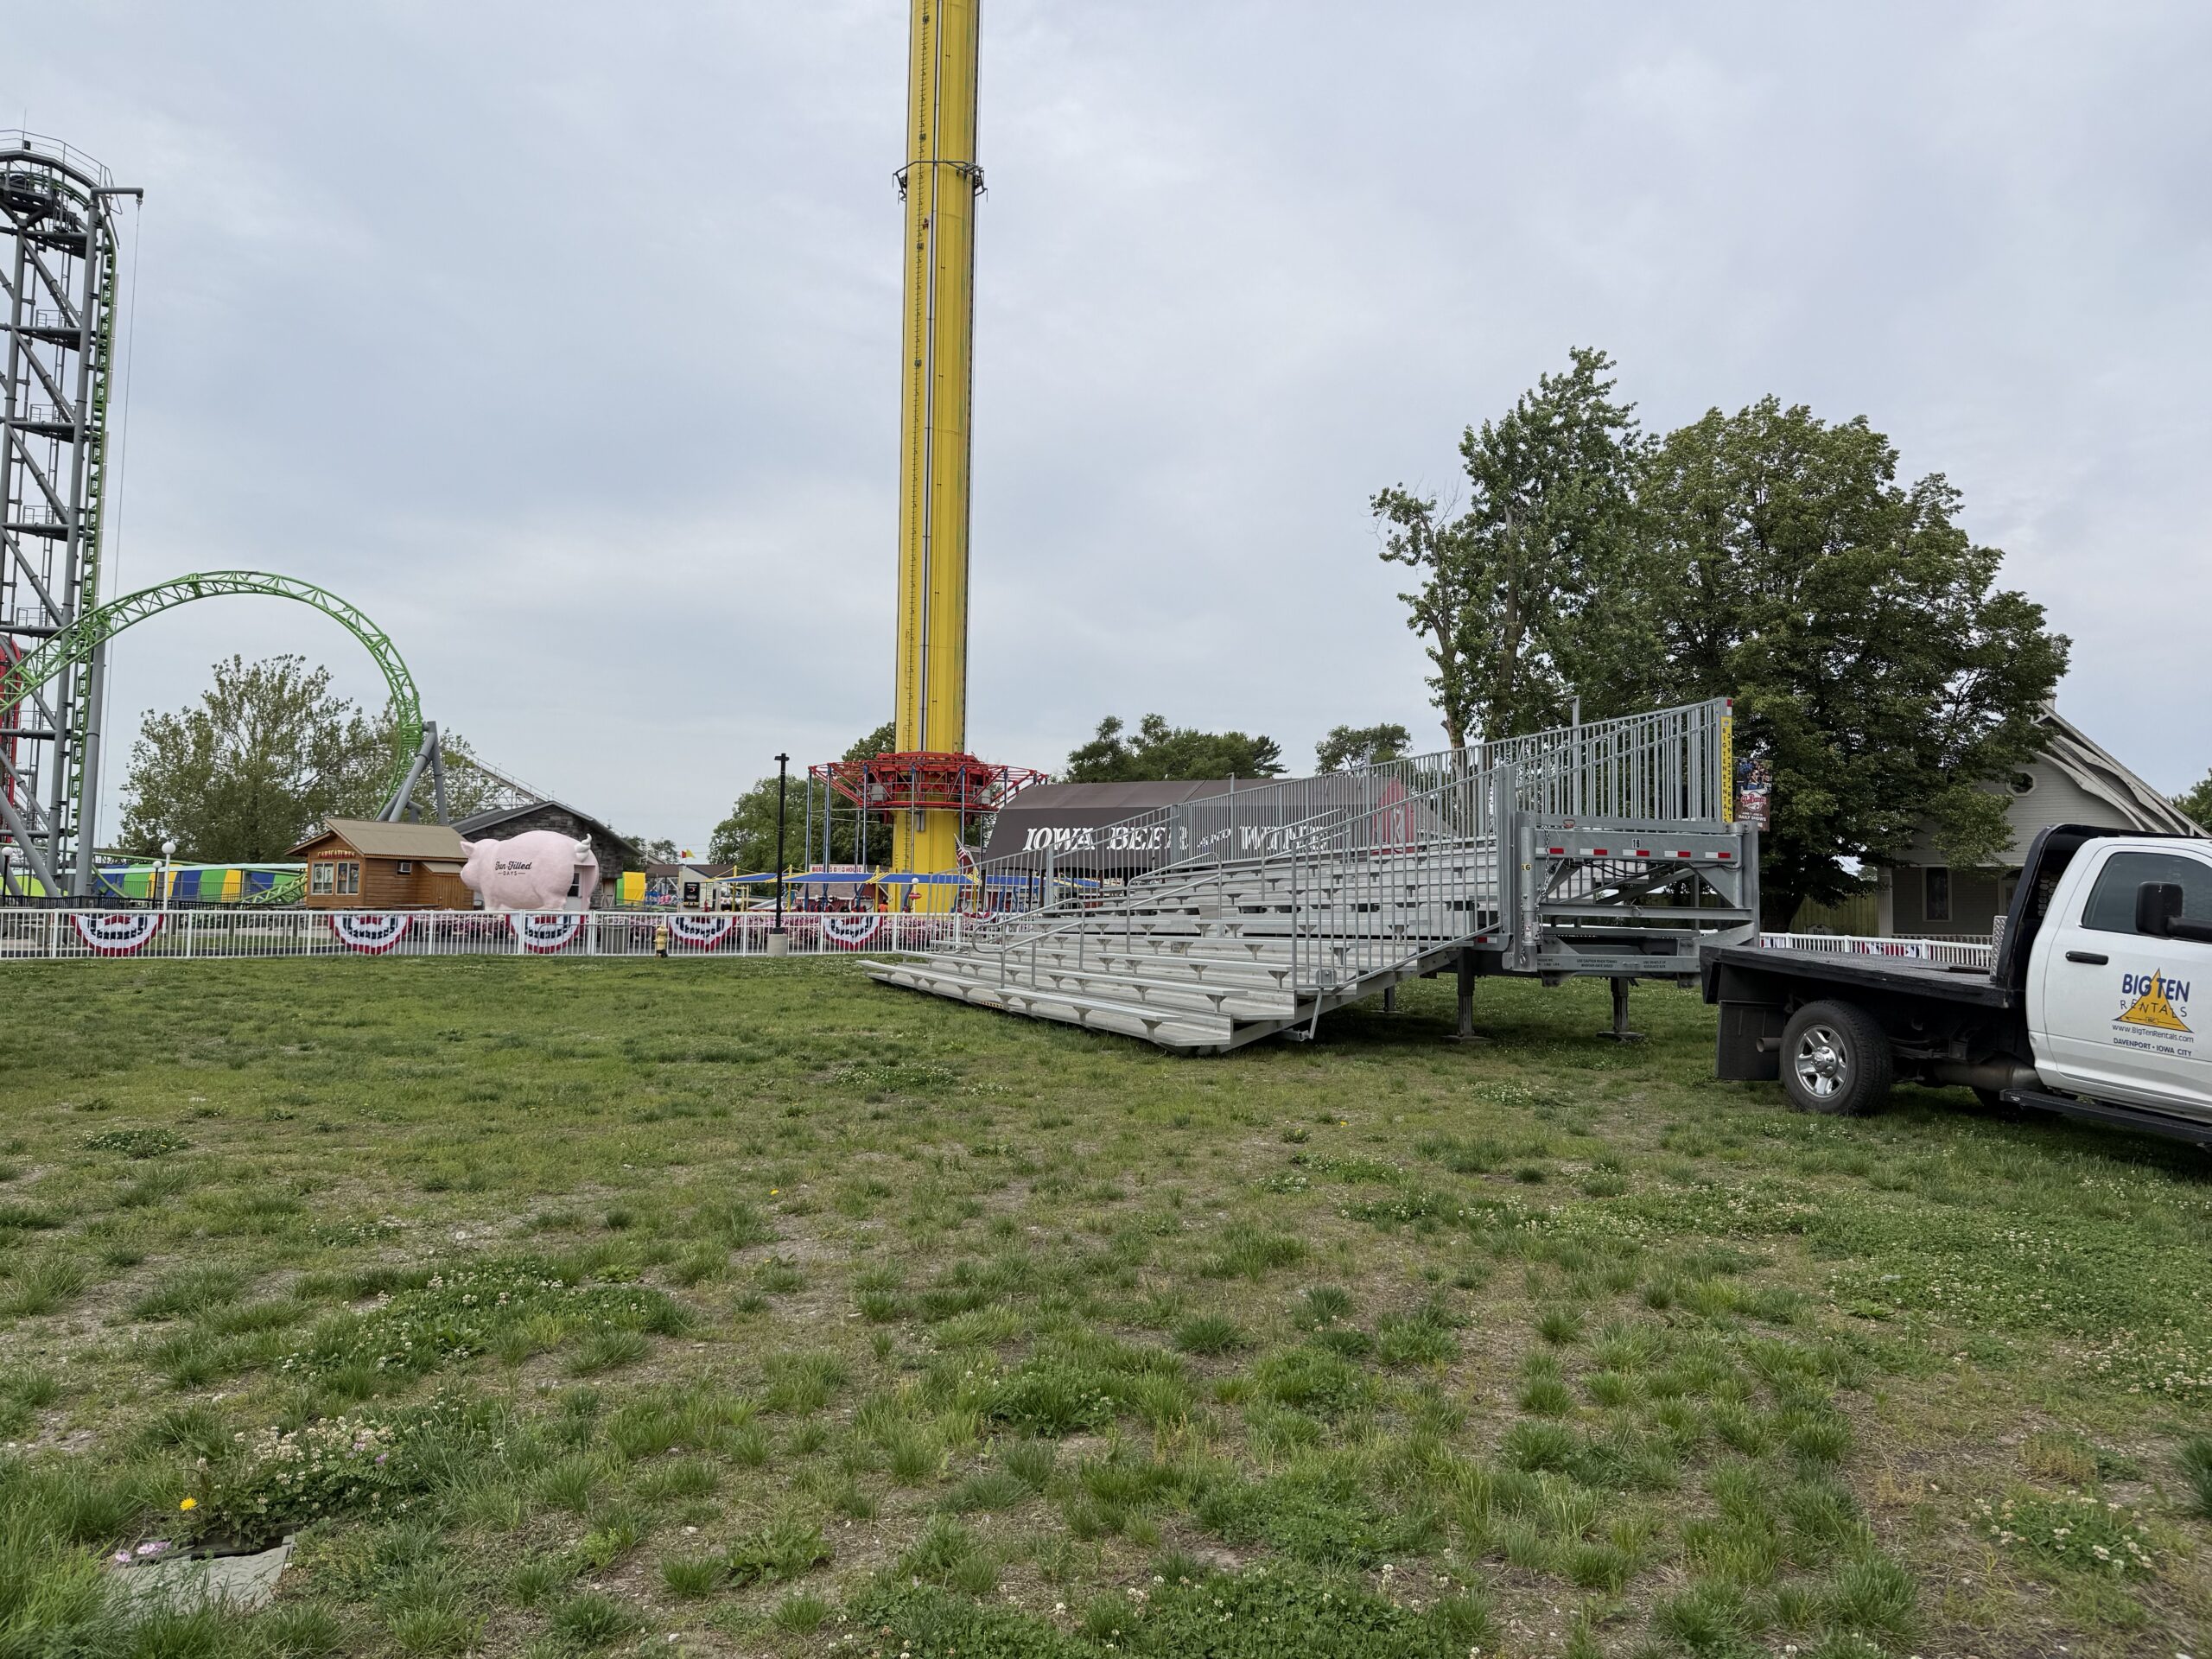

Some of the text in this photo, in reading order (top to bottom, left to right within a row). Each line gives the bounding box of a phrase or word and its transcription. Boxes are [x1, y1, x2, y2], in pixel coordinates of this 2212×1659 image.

[1022, 827, 1096, 851] IOWA
[1632, 839, 1640, 848] 16
[317, 849, 357, 858] CARICATURES
[495, 861, 533, 871] Fun Filled
[2121, 973, 2190, 1003] BIG TEN
[2120, 998, 2188, 1018] RENTALS
[2112, 1024, 2194, 1044] www.BigTenRentals.com
[2113, 1037, 2192, 1057] DAVENPORT IOWA CITY
